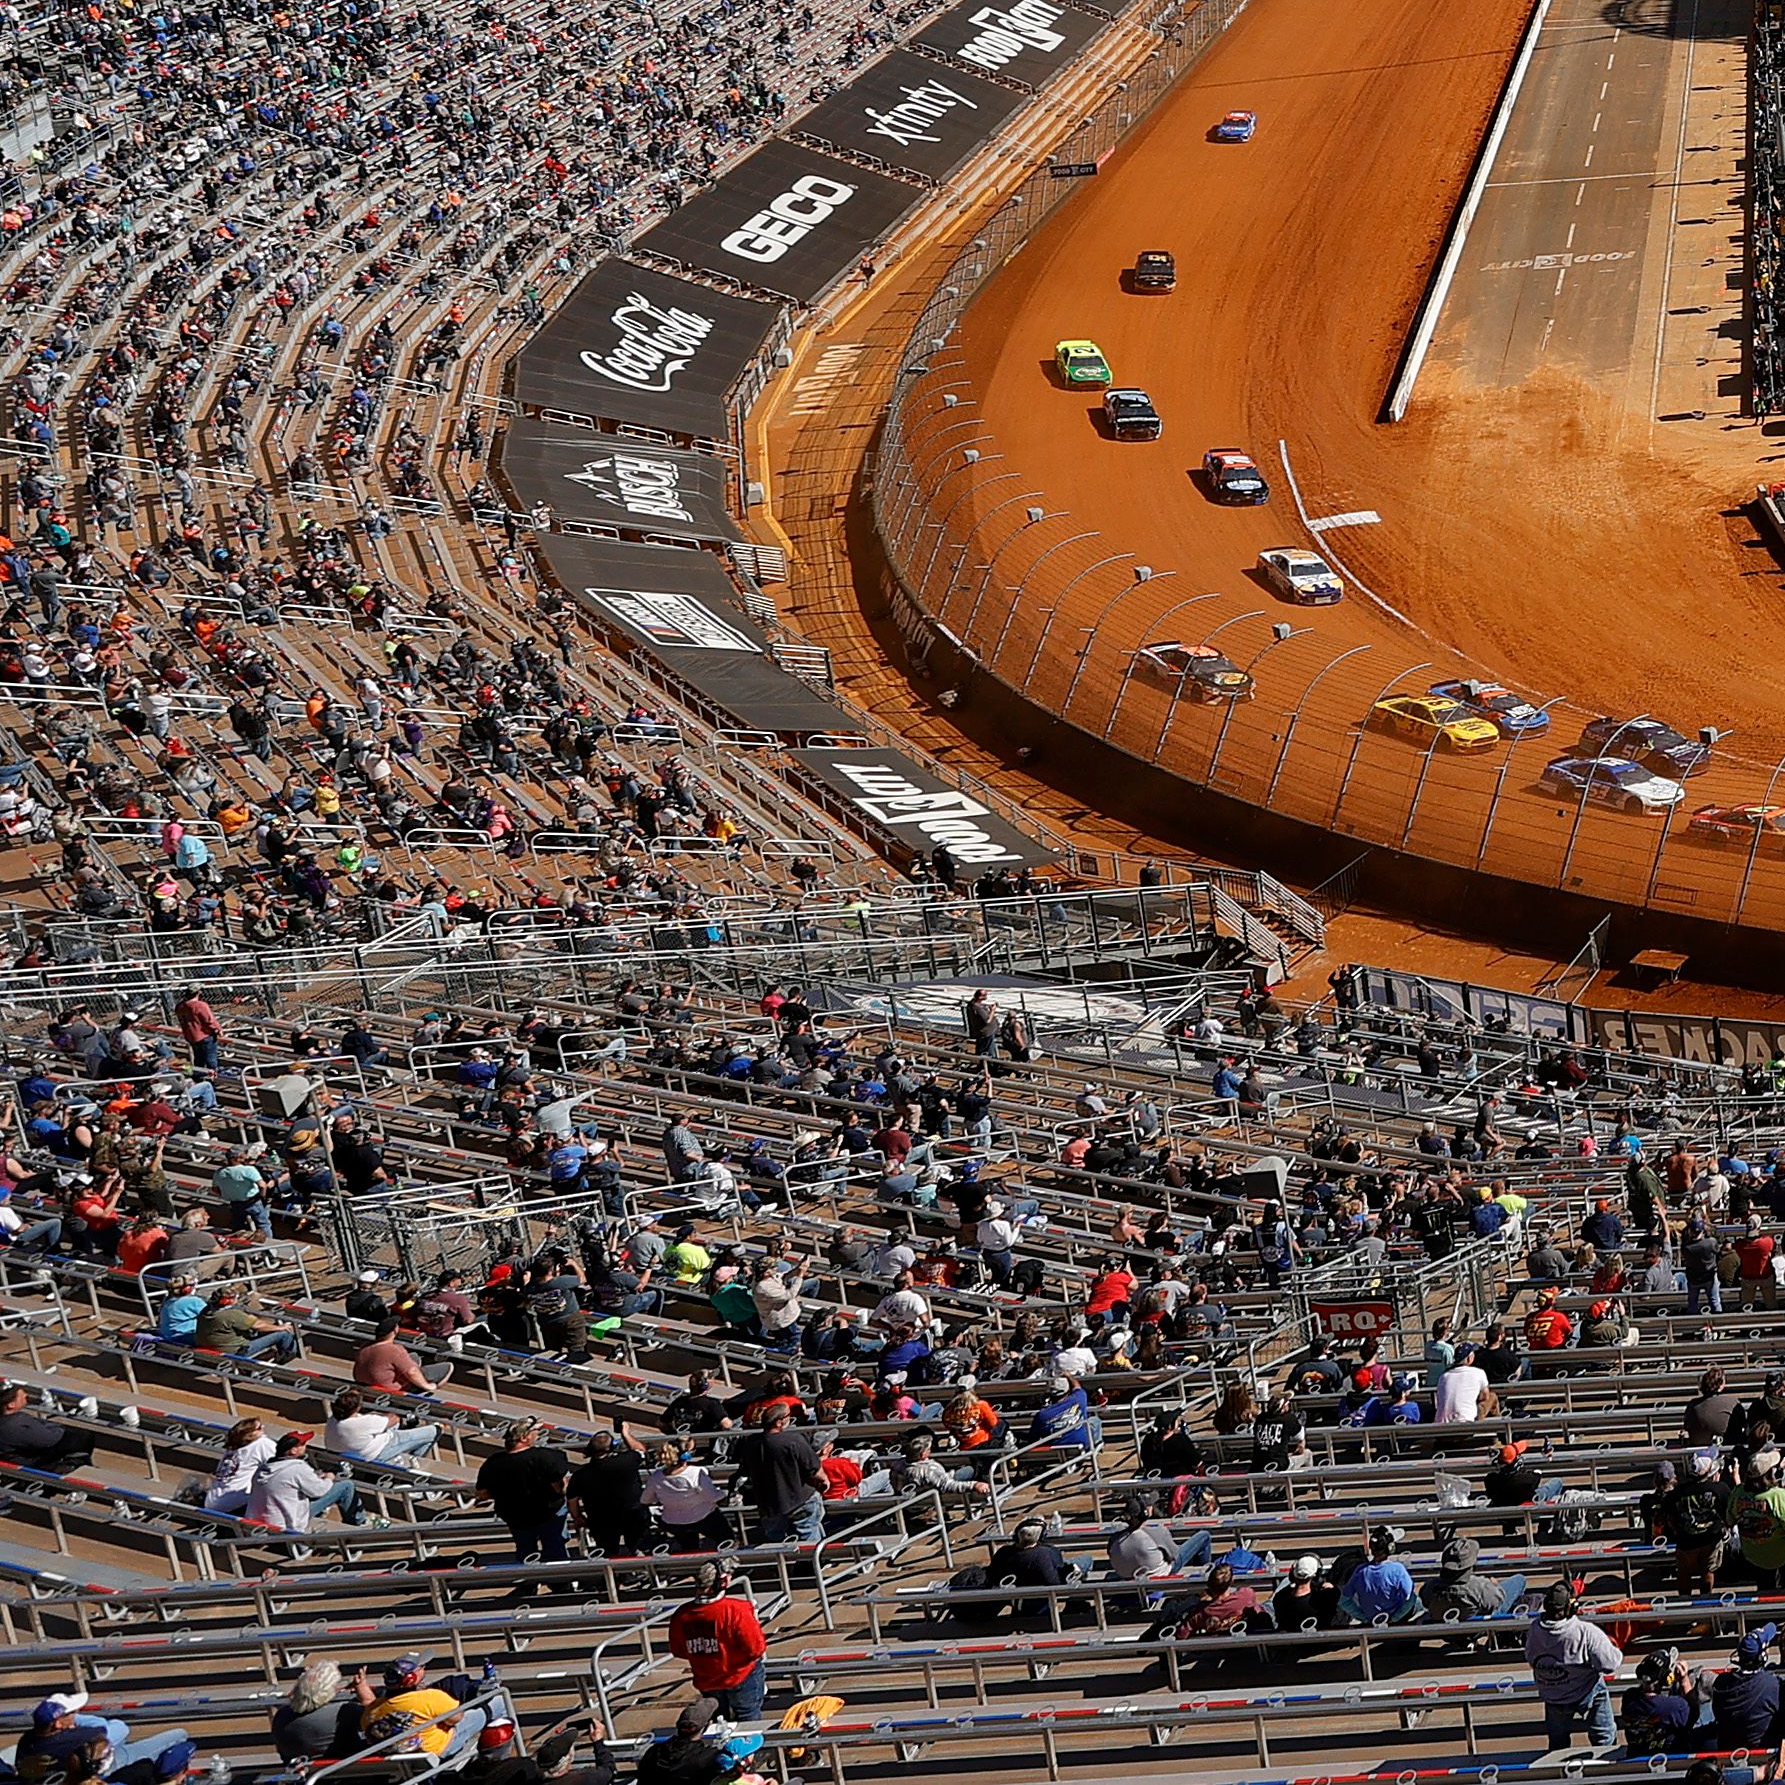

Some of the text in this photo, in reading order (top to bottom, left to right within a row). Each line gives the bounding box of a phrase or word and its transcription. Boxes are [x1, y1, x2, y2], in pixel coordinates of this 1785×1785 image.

[957, 27, 1020, 71] FOOD
[865, 78, 978, 146] xfinity
[1079, 165, 1095, 175] CITY
[720, 173, 855, 264] GEICO
[580, 290, 716, 392] Coca-Cola
[612, 453, 695, 523] BUSCH
[830, 761, 923, 799] CITY
[1330, 1311, 1378, 1332] RQ
[1527, 1321, 1553, 1337] 22
